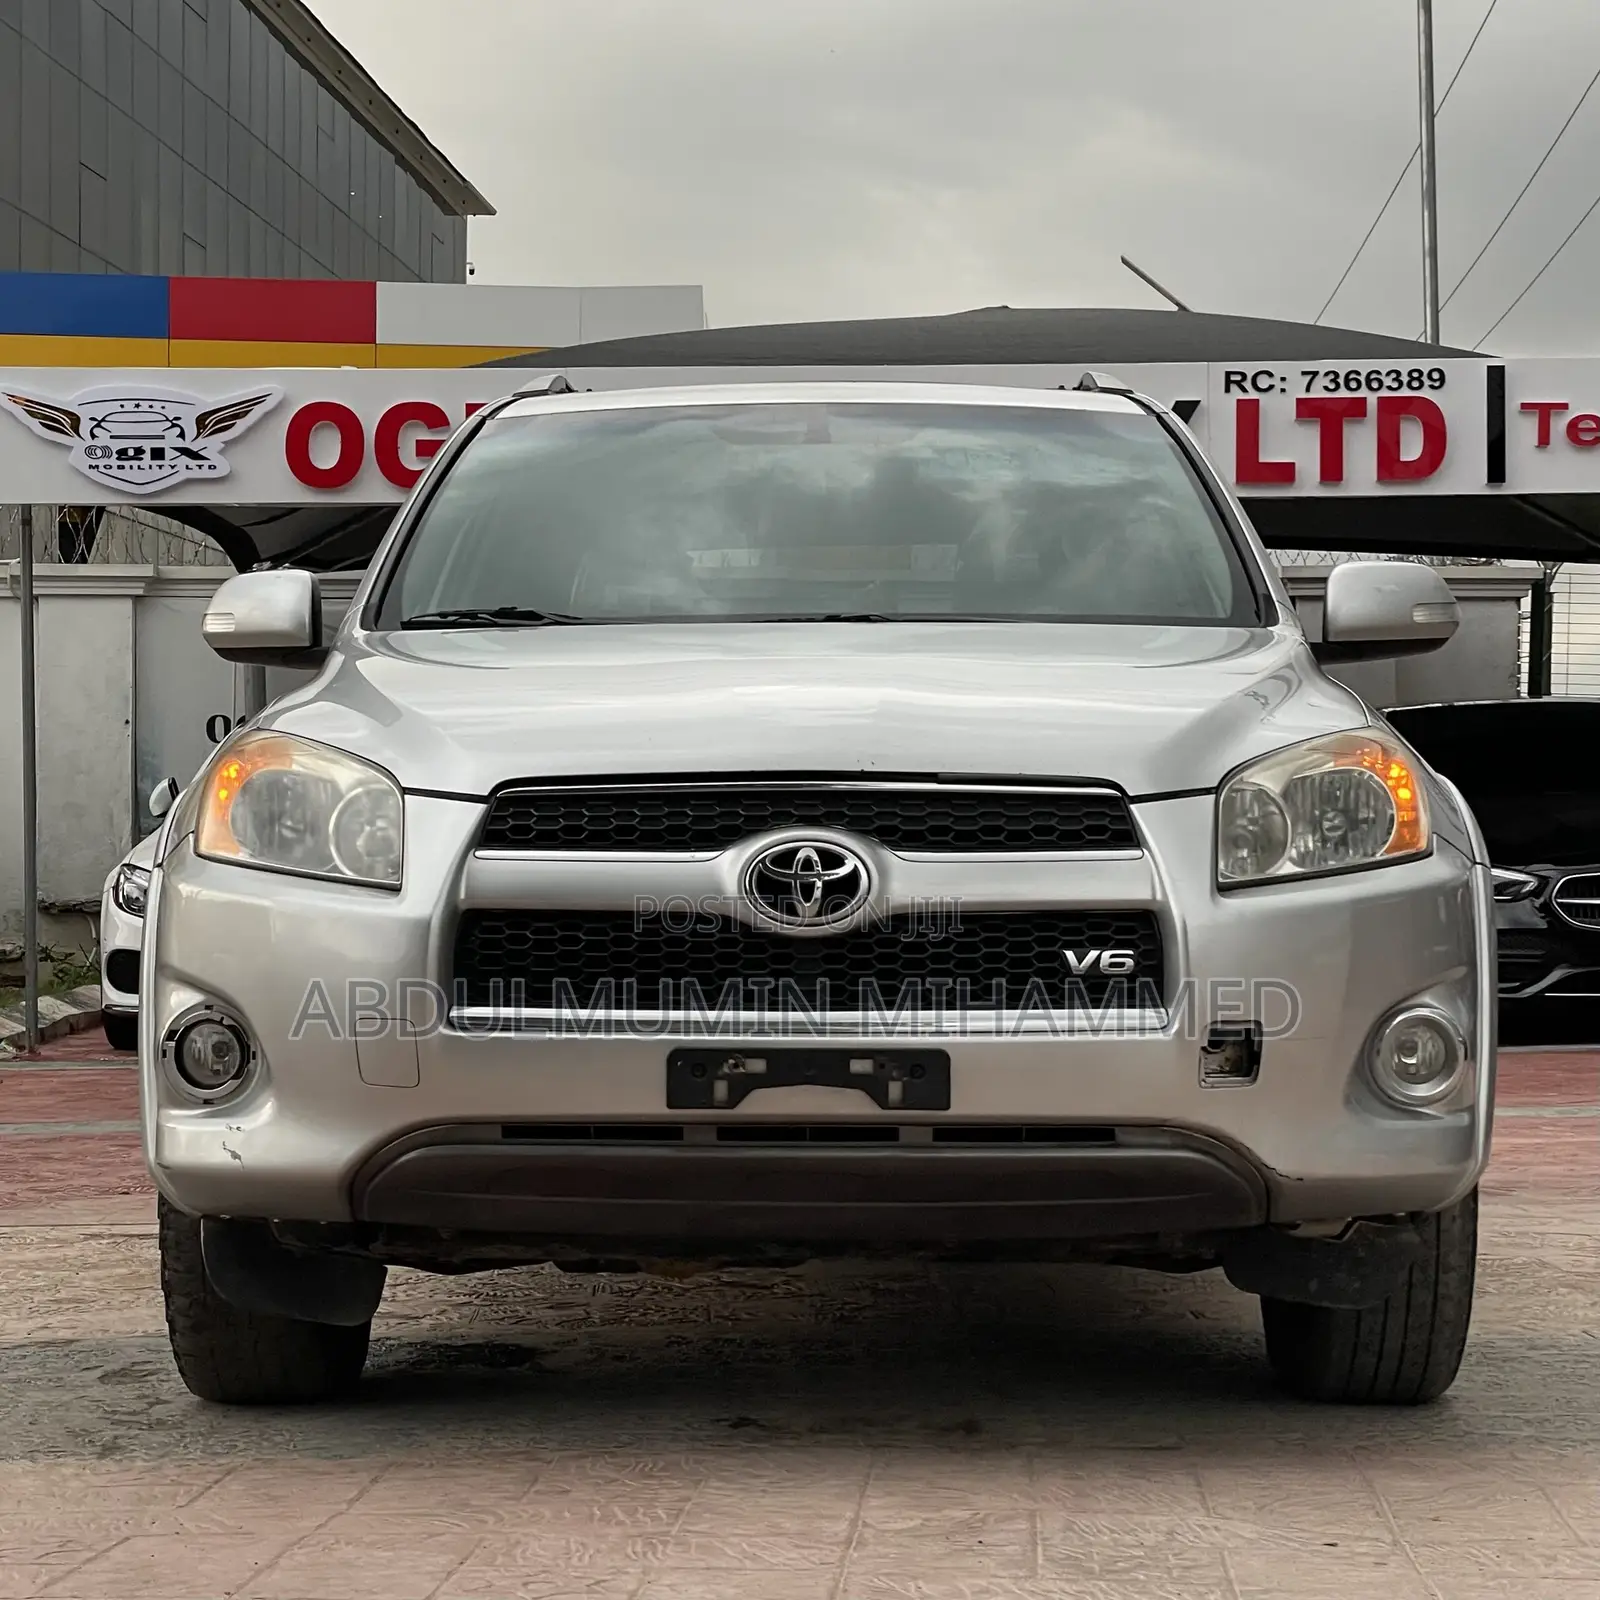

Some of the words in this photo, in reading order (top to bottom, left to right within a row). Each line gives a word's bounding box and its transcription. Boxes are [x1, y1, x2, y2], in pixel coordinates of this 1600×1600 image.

[1224, 370, 1287, 394] RC:
[1301, 367, 1446, 393] 7366389
[285, 401, 489, 488] OG
[1235, 396, 1447, 484] LTD
[1062, 949, 1135, 975] V6
